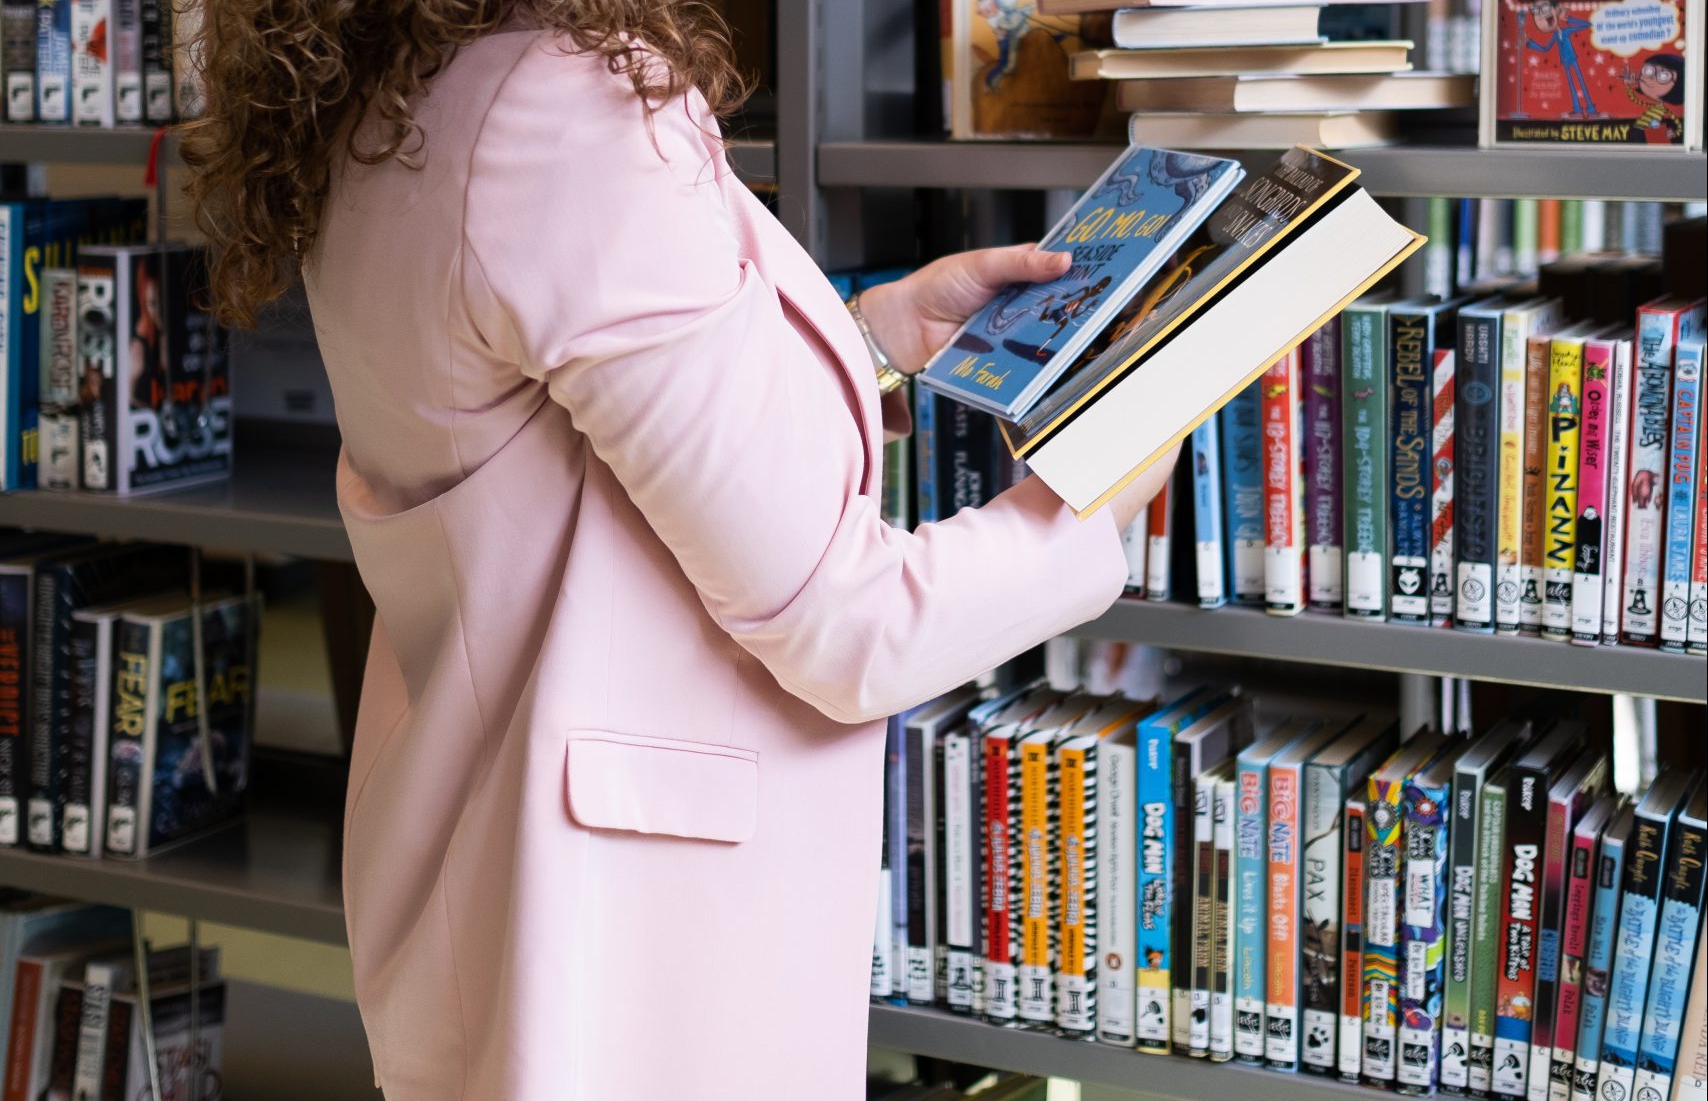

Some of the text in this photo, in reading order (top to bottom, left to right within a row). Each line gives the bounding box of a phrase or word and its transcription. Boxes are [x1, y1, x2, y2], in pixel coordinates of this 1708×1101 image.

[1639, 15, 1674, 28] youngest
[1561, 124, 1600, 141] STEVE
[1601, 124, 1630, 141] MAY
[1244, 176, 1308, 223] SONGBIRDS
[1134, 214, 1173, 238] GO!
[1222, 209, 1274, 249] SNAKES
[1072, 243, 1126, 263] SEASIDE
[78, 276, 112, 378] ROSE
[1464, 323, 1475, 363] HARDY
[949, 355, 1012, 390] Mo Farah
[1394, 326, 1425, 499] REBEL OF THE SANDS
[1614, 393, 1622, 425] RUSSELL
[1672, 388, 1695, 485] CAPTAIN PUG
[1670, 504, 1688, 542] LAURA
[110, 650, 151, 737] FEAR
[1142, 802, 1165, 875] DOG MAN
[1236, 815, 1260, 860] NATE
[1268, 820, 1291, 864] NATE
[1636, 824, 1660, 850] Ruth
[1678, 830, 1703, 856] Ruth
[1241, 870, 1256, 901] Lives
[1271, 872, 1286, 910] Blasts
[1305, 858, 1326, 902] PAX
[1416, 873, 1430, 912] WHAT
[1452, 864, 1474, 894] DOG
[1509, 842, 1538, 921] DOG MAN
[1567, 883, 1585, 923] Leggings
[1194, 896, 1210, 968] ANIMAL FARM
[1214, 901, 1228, 972] ANIMAL FARM
[1236, 916, 1256, 935] Up
[1567, 924, 1582, 951] Revolt
[1621, 907, 1645, 949] BATTLE
[1661, 913, 1686, 955] BATTLE
[1561, 989, 1575, 1015] Polak
[1613, 970, 1636, 1014] BLIGHTY
[1653, 977, 1676, 1021] BLIGHTY
